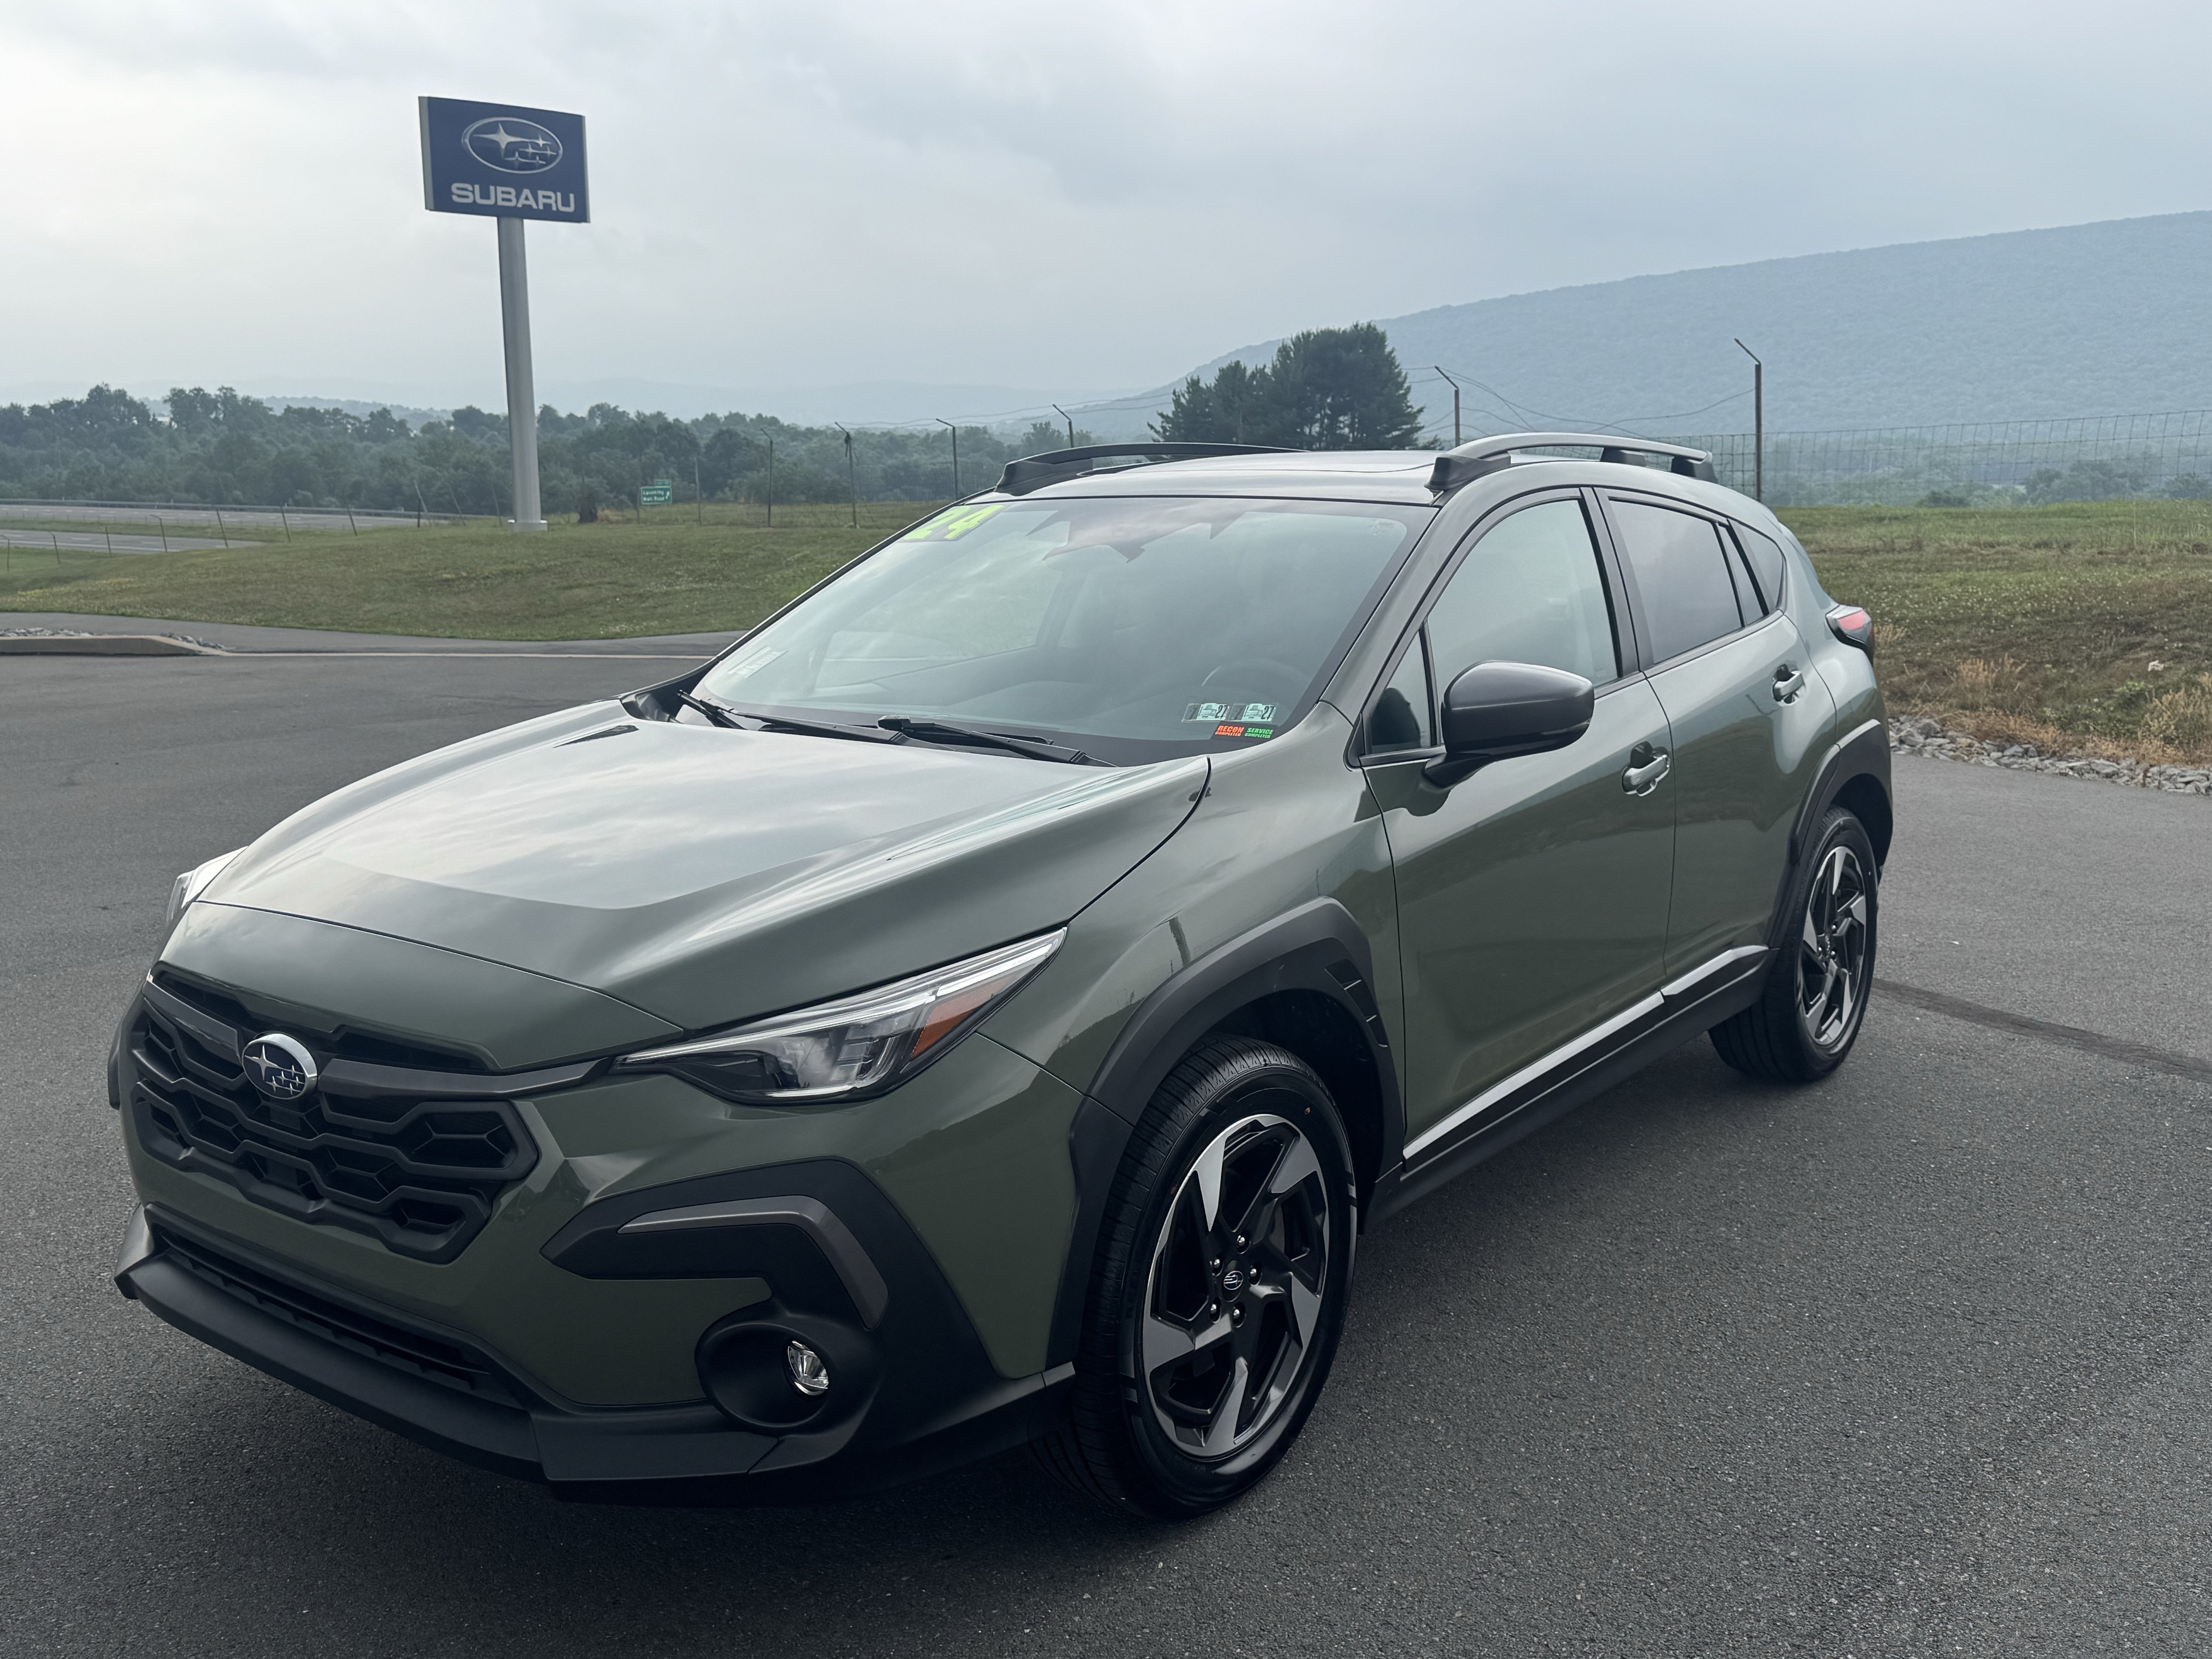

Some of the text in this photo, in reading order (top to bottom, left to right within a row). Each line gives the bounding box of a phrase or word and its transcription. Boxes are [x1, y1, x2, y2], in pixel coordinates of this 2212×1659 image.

[451, 183, 575, 213] SUBARU
[903, 505, 1005, 540] 24
[1215, 704, 1227, 720] 27
[1261, 705, 1275, 720] 27
[1217, 725, 1245, 733] RECON
